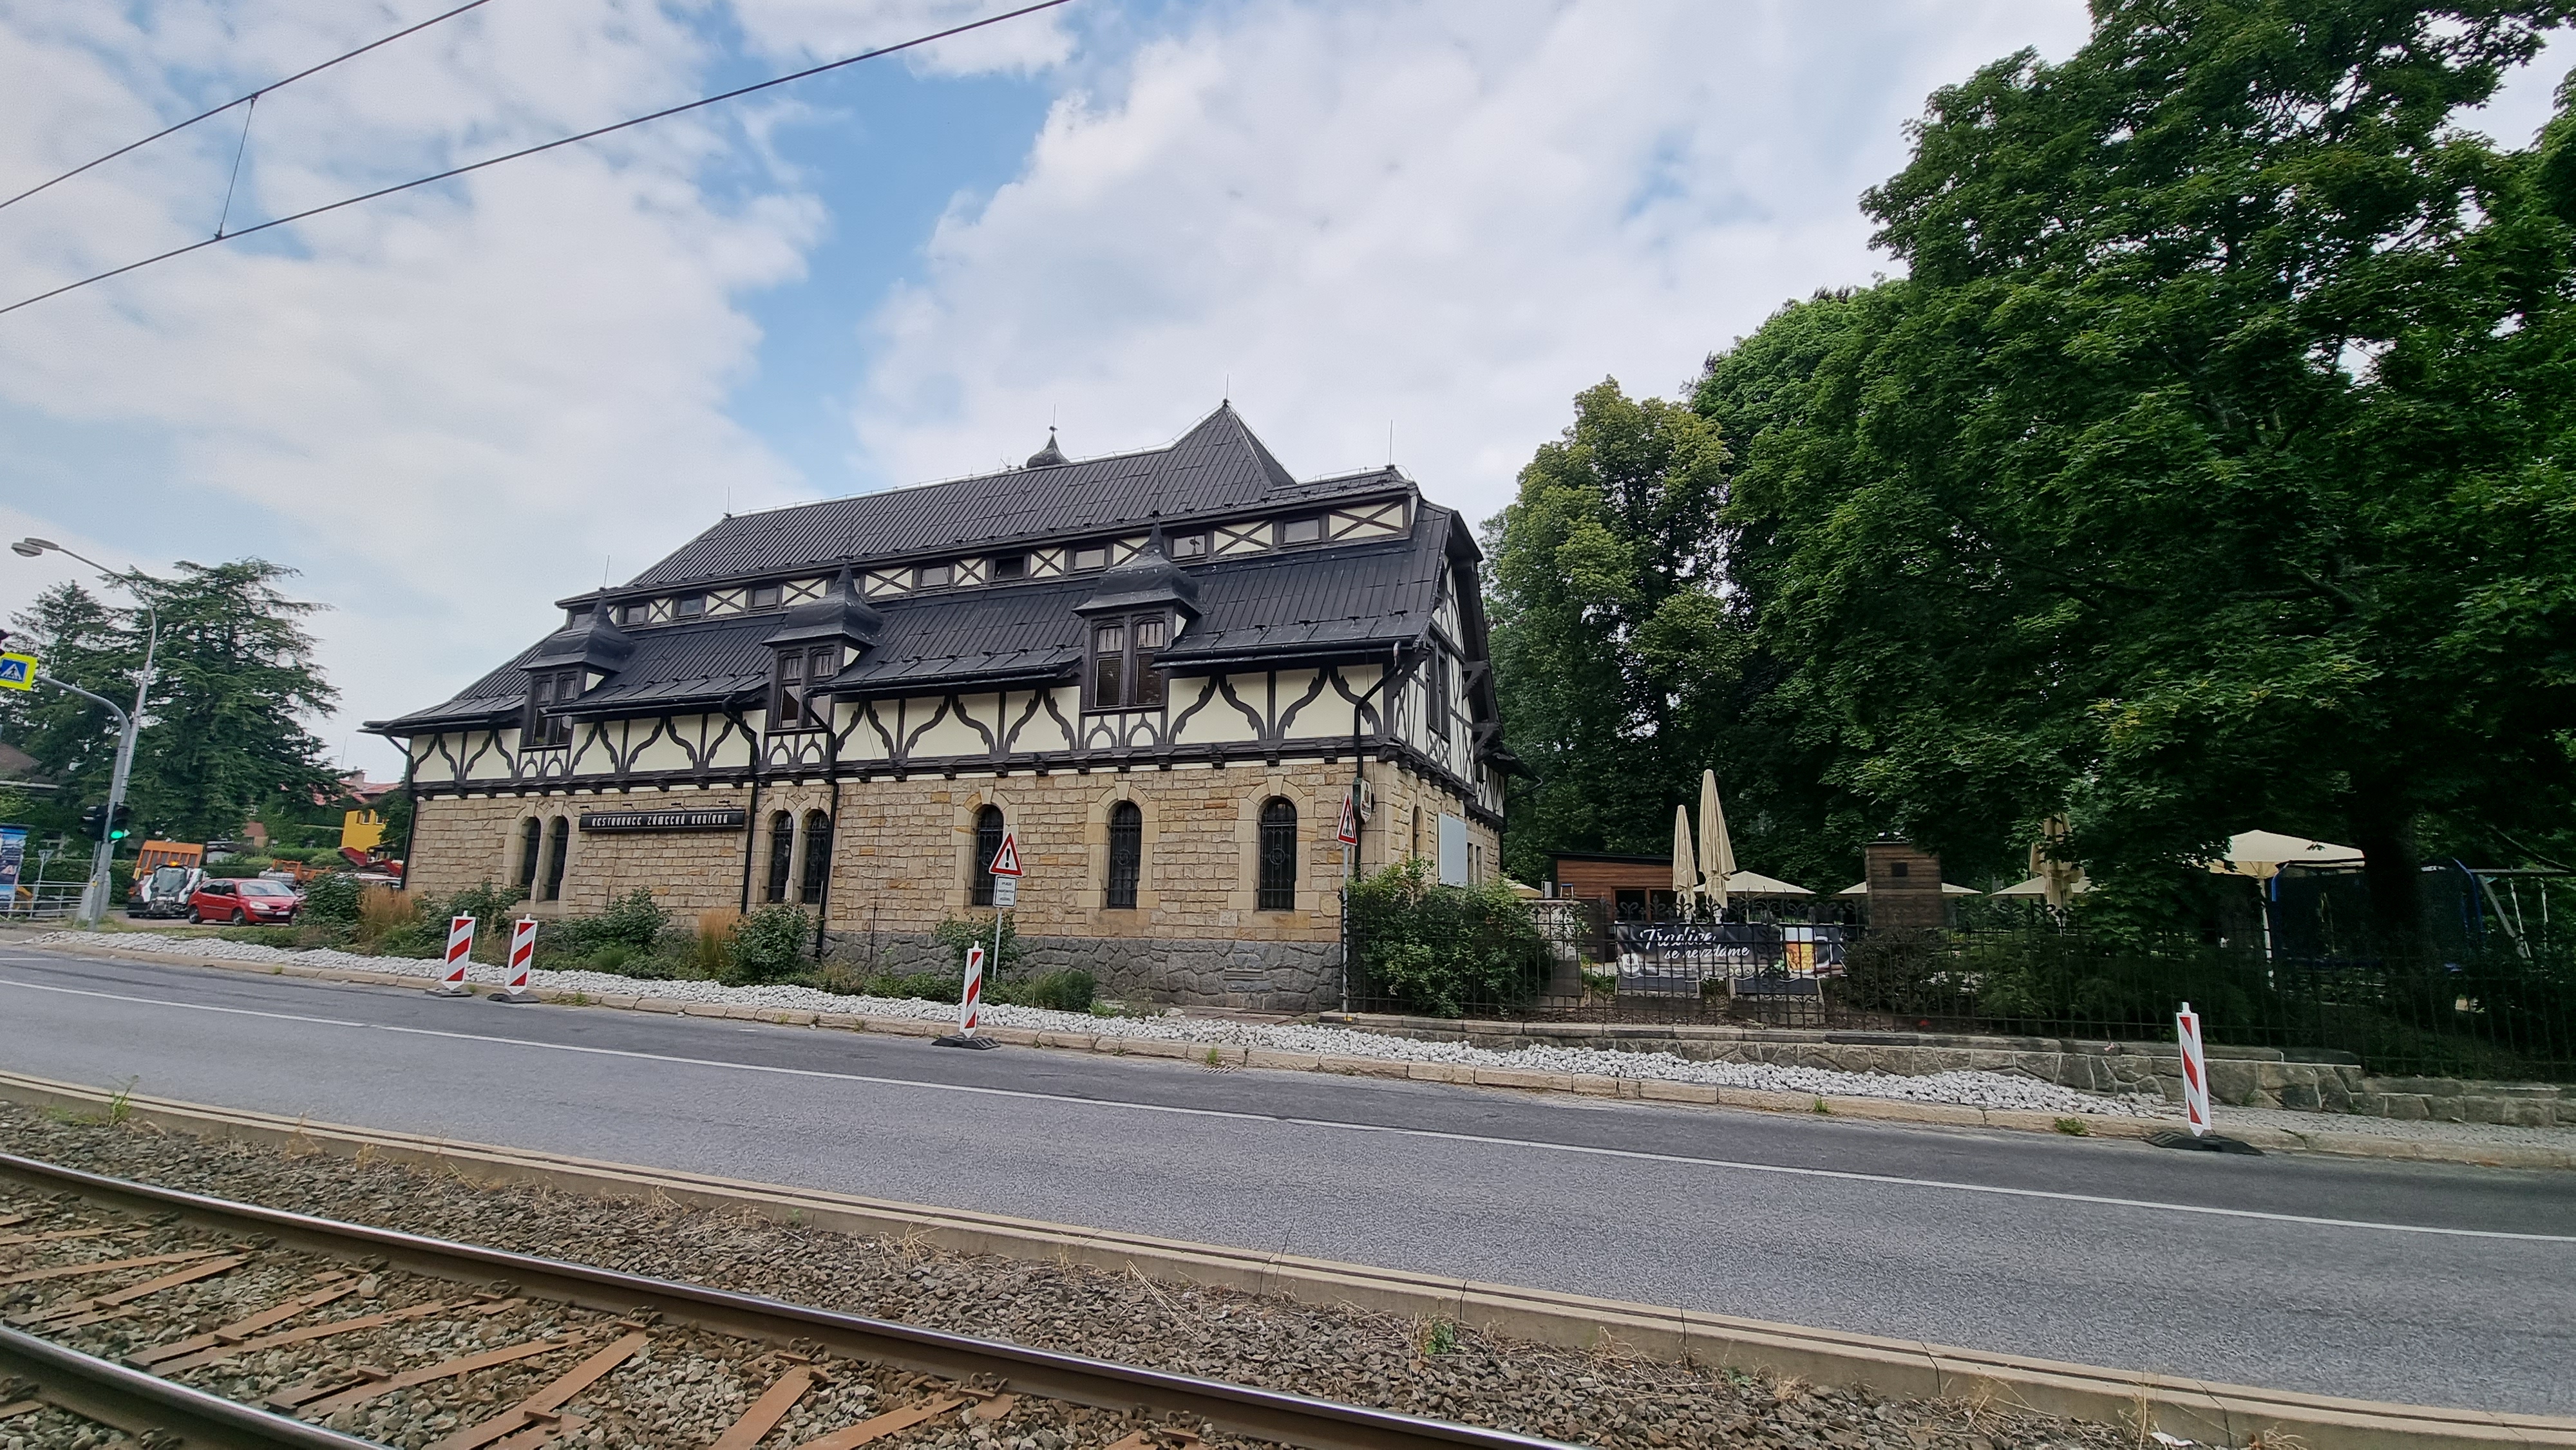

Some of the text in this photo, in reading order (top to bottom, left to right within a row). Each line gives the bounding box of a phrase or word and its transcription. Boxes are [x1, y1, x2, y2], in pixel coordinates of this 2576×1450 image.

[592, 813, 728, 827] RESTAURACE ZÁMECKÁ KONÍRNA
[1664, 943, 1750, 959] se nevzdáme
